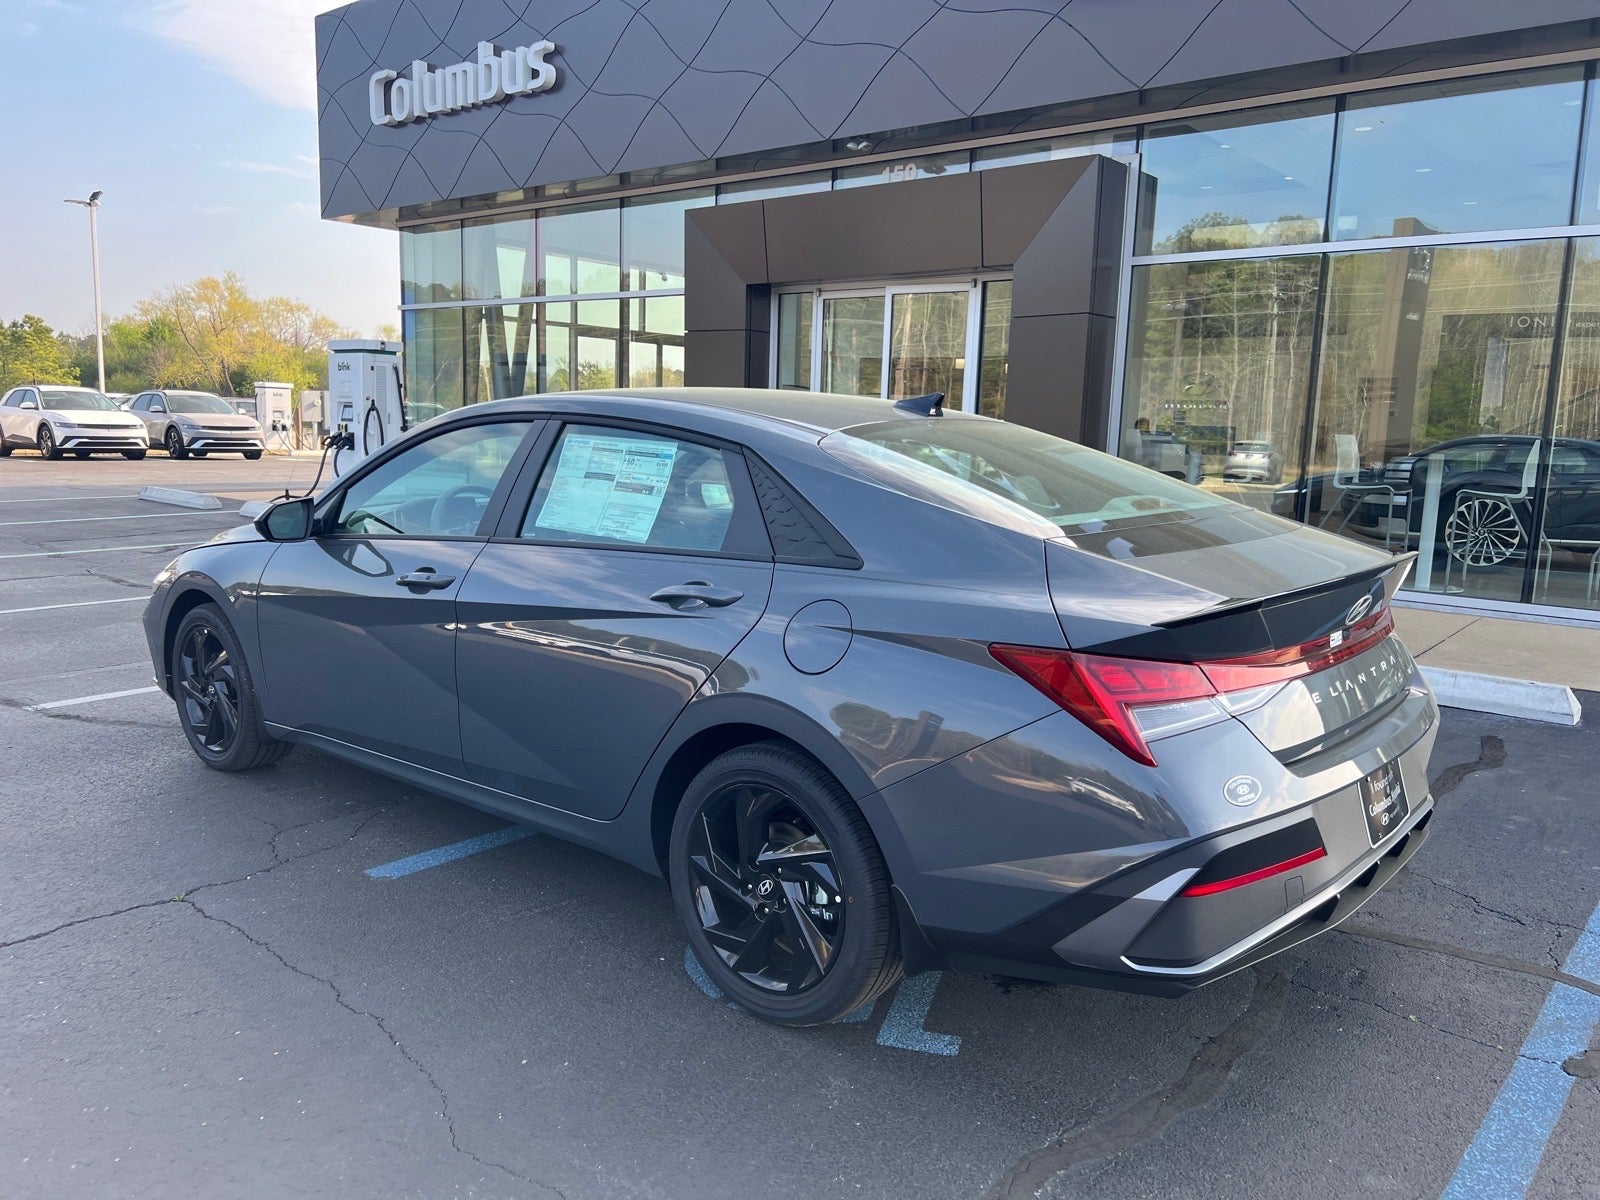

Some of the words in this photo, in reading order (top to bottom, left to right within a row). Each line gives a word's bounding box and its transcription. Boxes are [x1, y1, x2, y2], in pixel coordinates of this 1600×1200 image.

[369, 39, 557, 126] Columbus
[882, 162, 918, 183] 150
[1509, 315, 1563, 328] IONI
[337, 361, 351, 371] blink
[1311, 655, 1397, 704] ELANTRA
